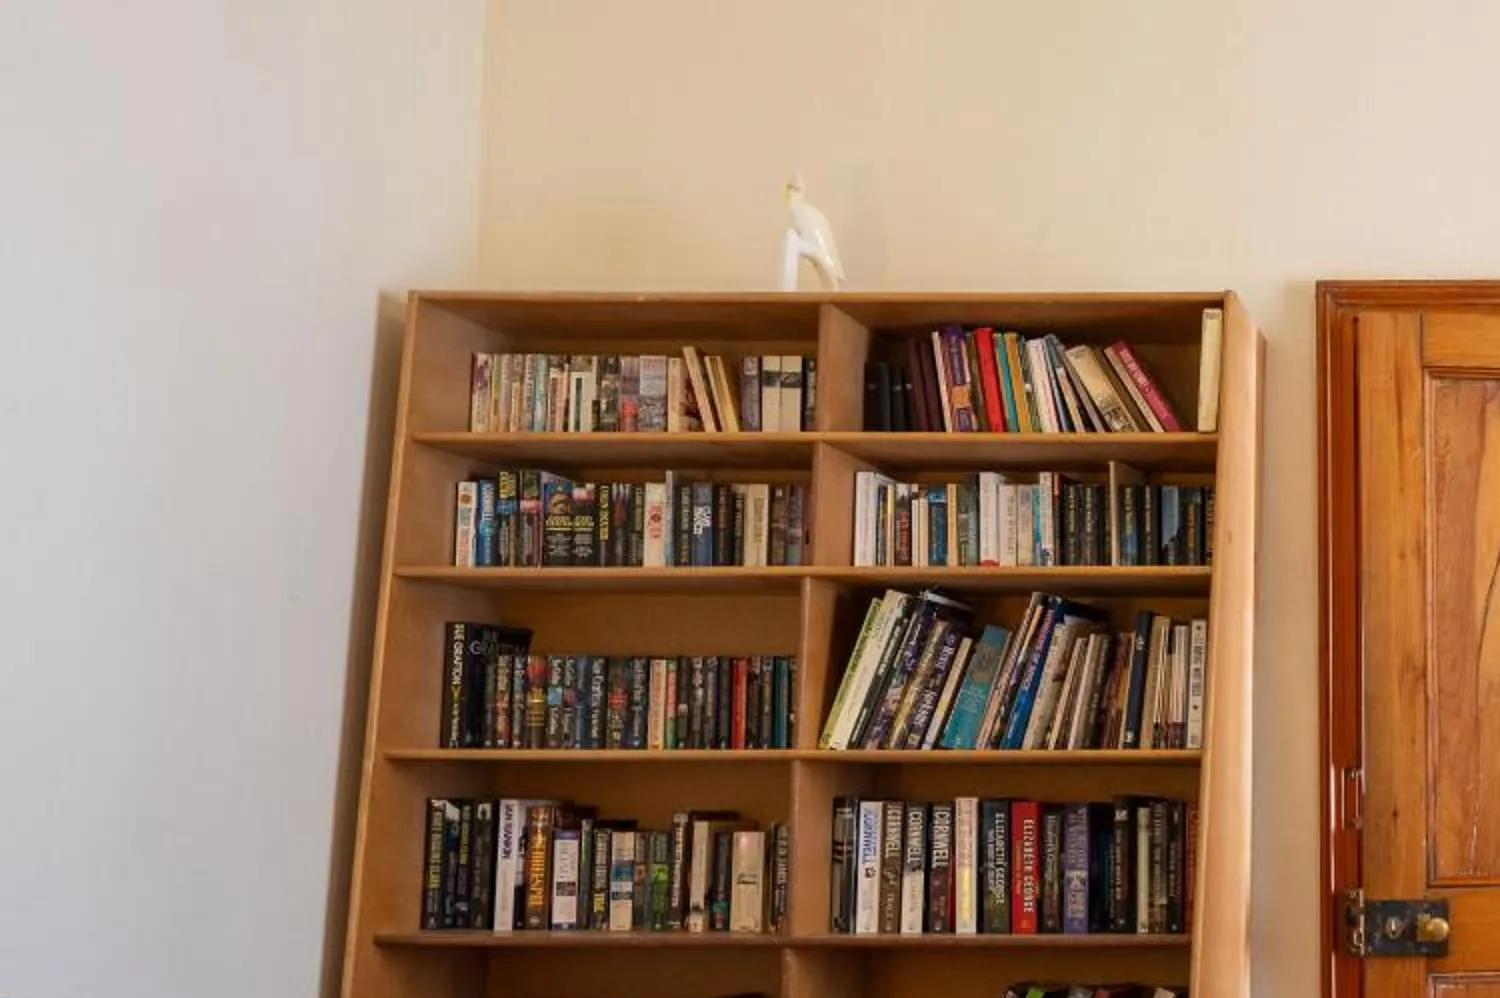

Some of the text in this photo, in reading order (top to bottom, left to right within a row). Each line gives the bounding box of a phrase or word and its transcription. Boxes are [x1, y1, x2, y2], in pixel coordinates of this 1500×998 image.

[452, 642, 464, 684] GRAFTON
[907, 812, 923, 864] CORNWELL
[931, 811, 949, 869] CORNWELL
[995, 812, 1006, 905] ELIZABETH GEORGE
[1023, 819, 1035, 913] ELIZABETH GEORGE
